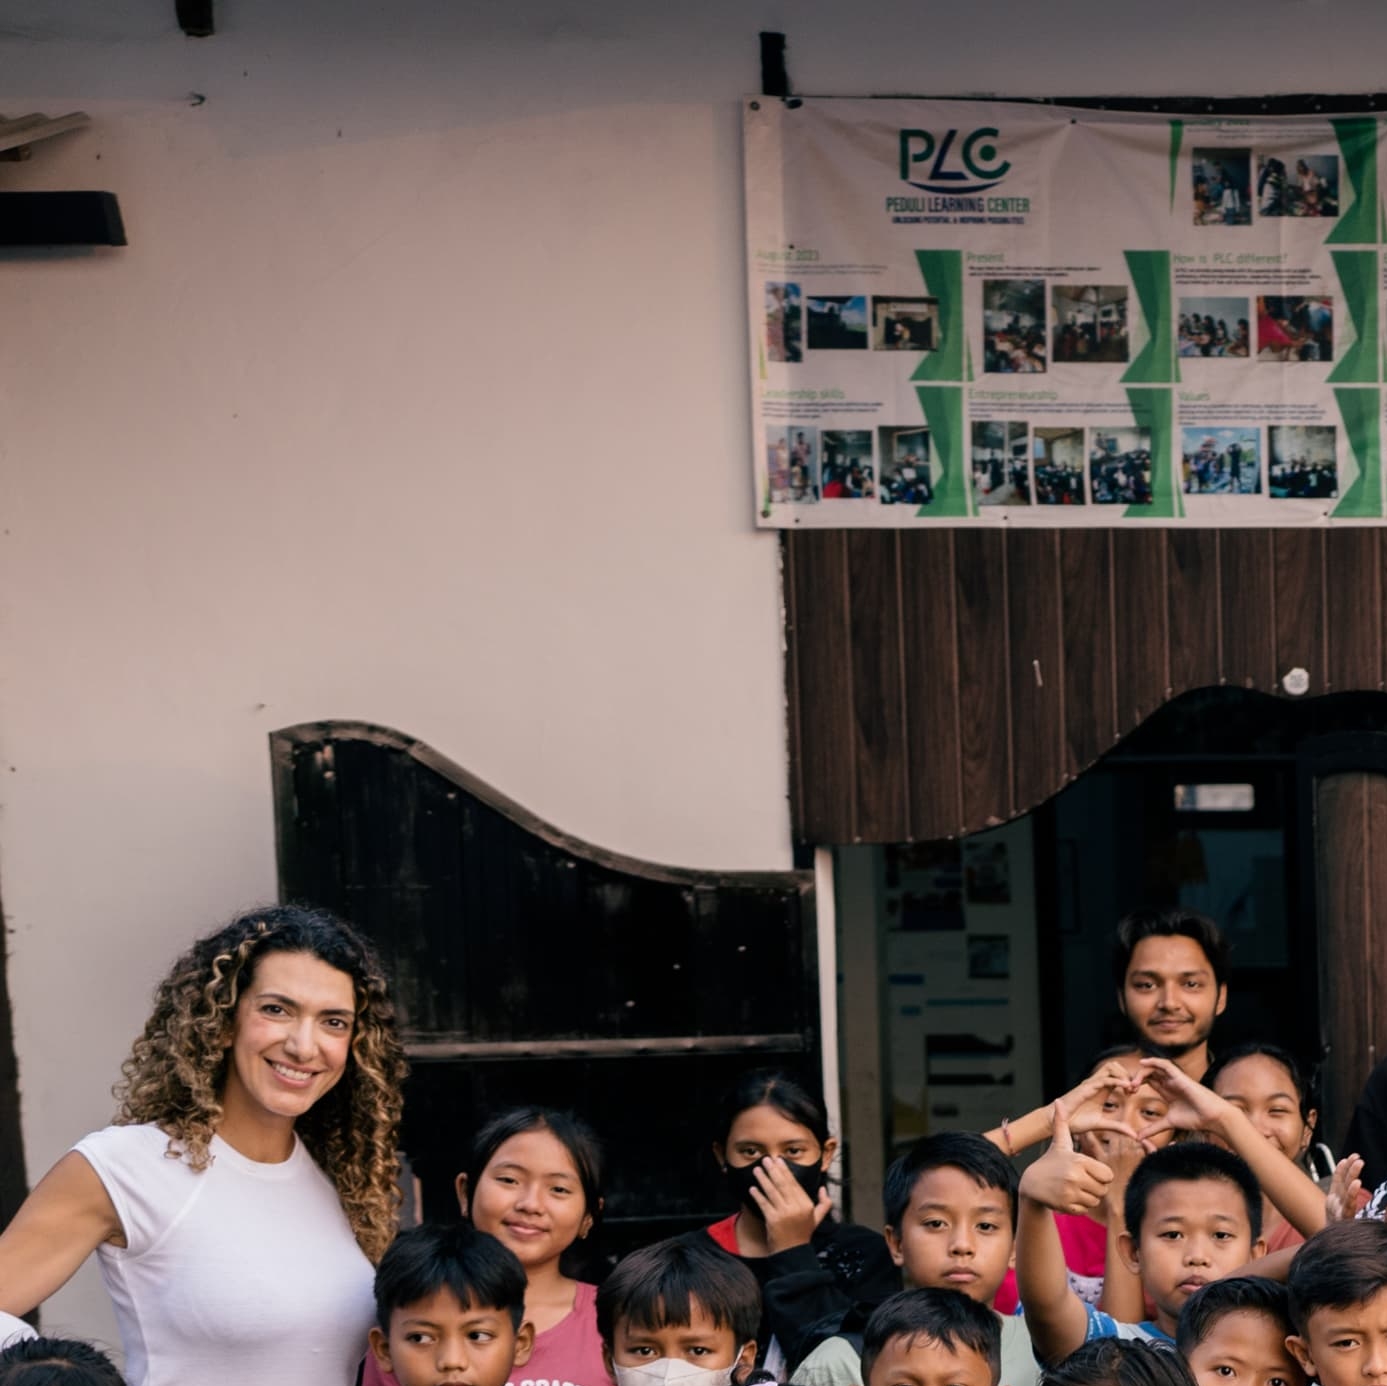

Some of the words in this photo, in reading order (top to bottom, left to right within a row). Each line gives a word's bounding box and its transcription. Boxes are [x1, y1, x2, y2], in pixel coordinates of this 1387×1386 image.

[899, 127, 1012, 181] PLC
[886, 197, 925, 213] PEDULI
[928, 197, 985, 213] LEARNING
[987, 197, 1030, 213] CENTER
[967, 252, 1005, 263] Present
[1213, 253, 1233, 263] PLC
